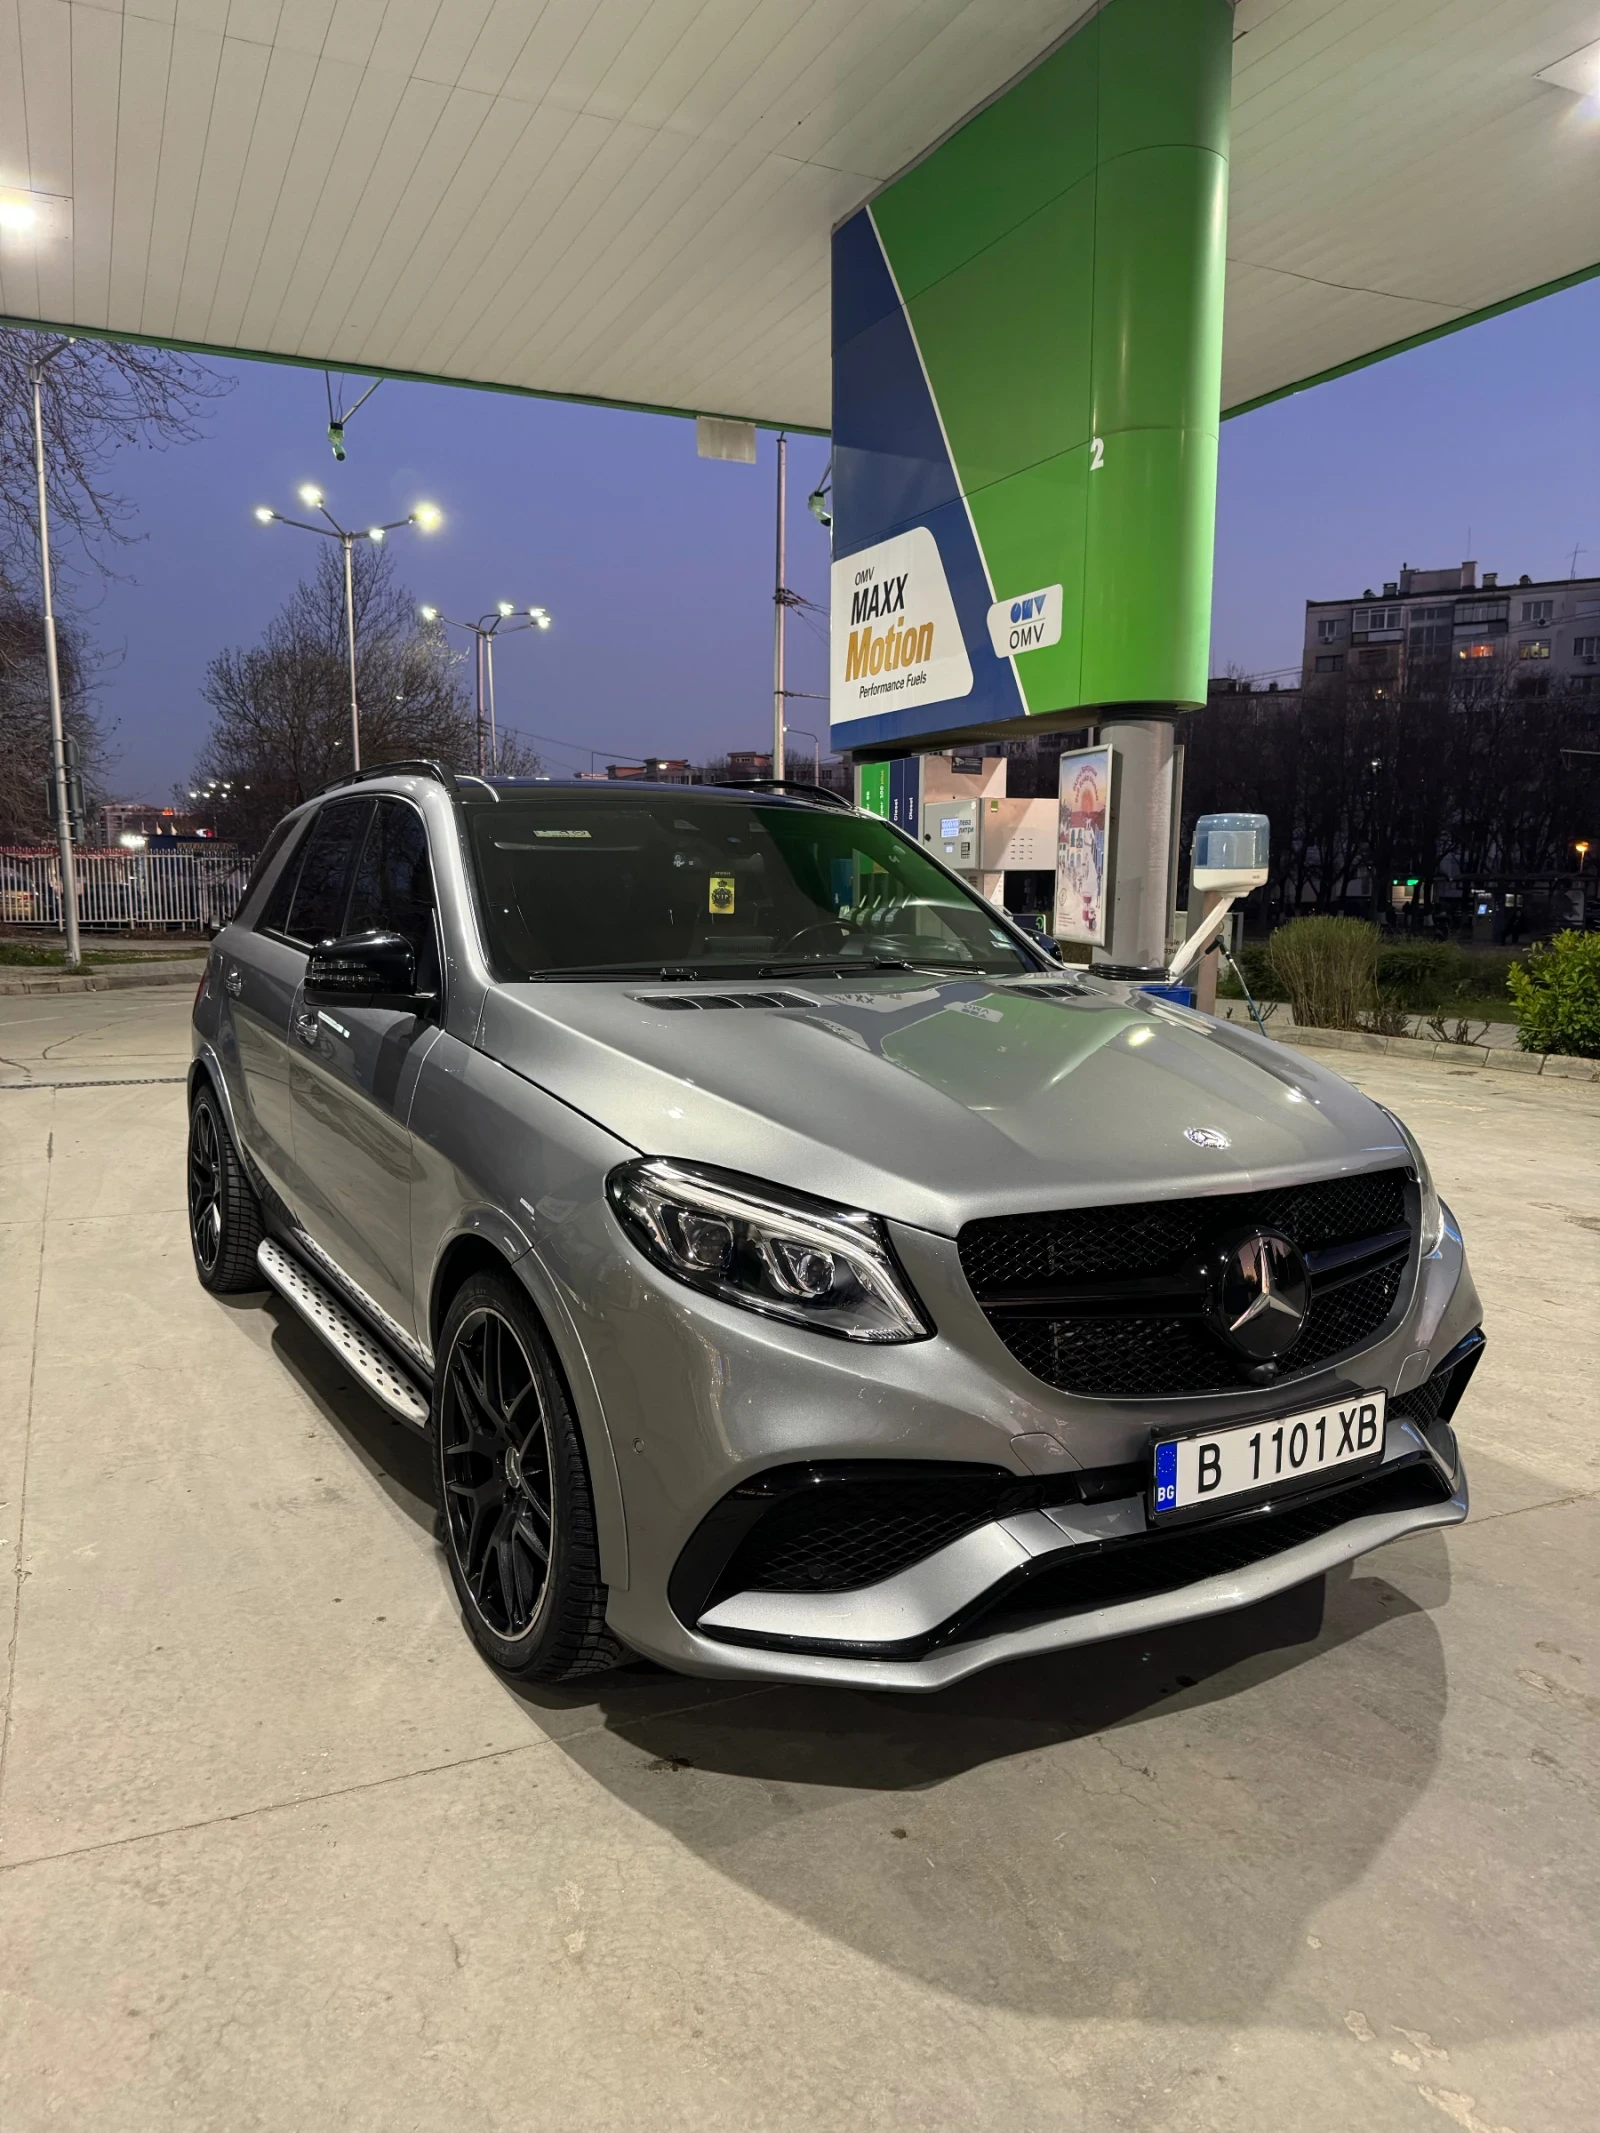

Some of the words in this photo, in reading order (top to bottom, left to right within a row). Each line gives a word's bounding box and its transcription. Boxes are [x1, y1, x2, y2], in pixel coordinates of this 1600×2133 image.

[1090, 437, 1105, 471] 2
[854, 566, 875, 587] OMV
[850, 573, 909, 626] MAXX
[845, 616, 934, 683] Motion
[1009, 622, 1045, 650] OMV
[859, 679, 905, 699] Performance
[906, 670, 927, 688] Fuels
[1198, 1442, 1222, 1494] B
[1249, 1416, 1327, 1480] 1101
[1336, 1403, 1377, 1458] XB
[1157, 1484, 1175, 1502] BG
